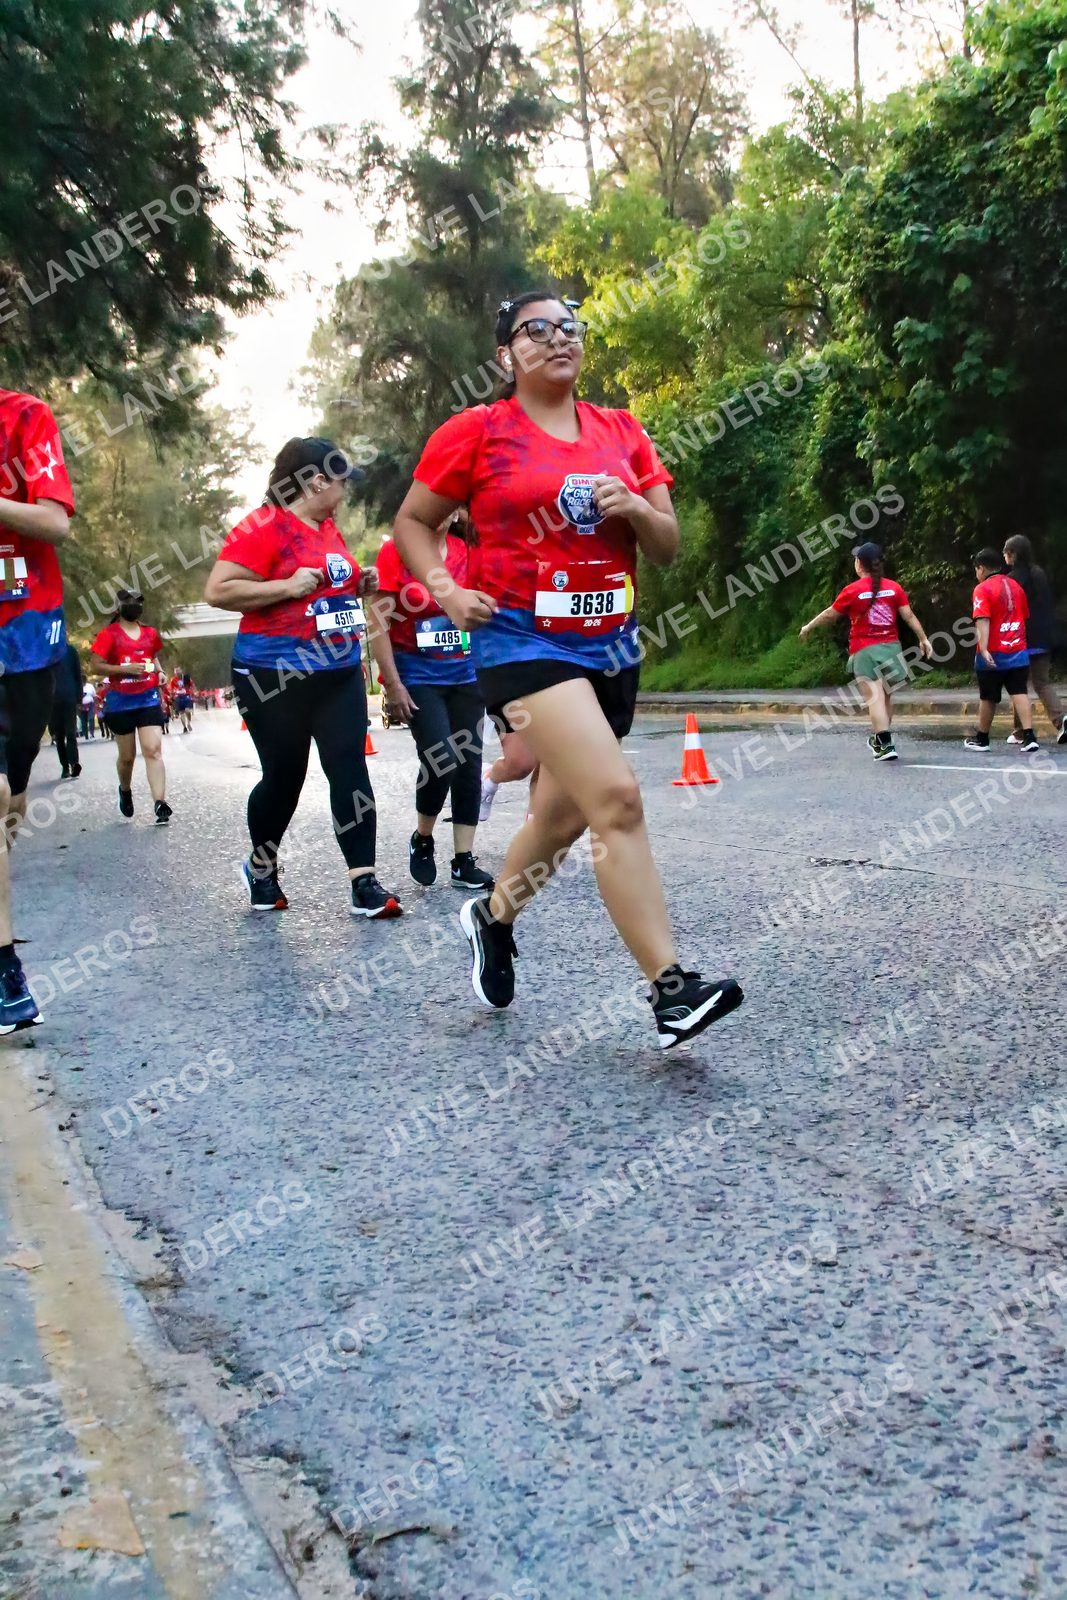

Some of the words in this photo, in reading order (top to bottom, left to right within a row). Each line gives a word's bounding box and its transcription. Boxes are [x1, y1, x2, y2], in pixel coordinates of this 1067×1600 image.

[567, 498, 591, 506] Race
[570, 591, 614, 616] 3638
[335, 611, 354, 627] 4516
[434, 631, 460, 645] 4485
